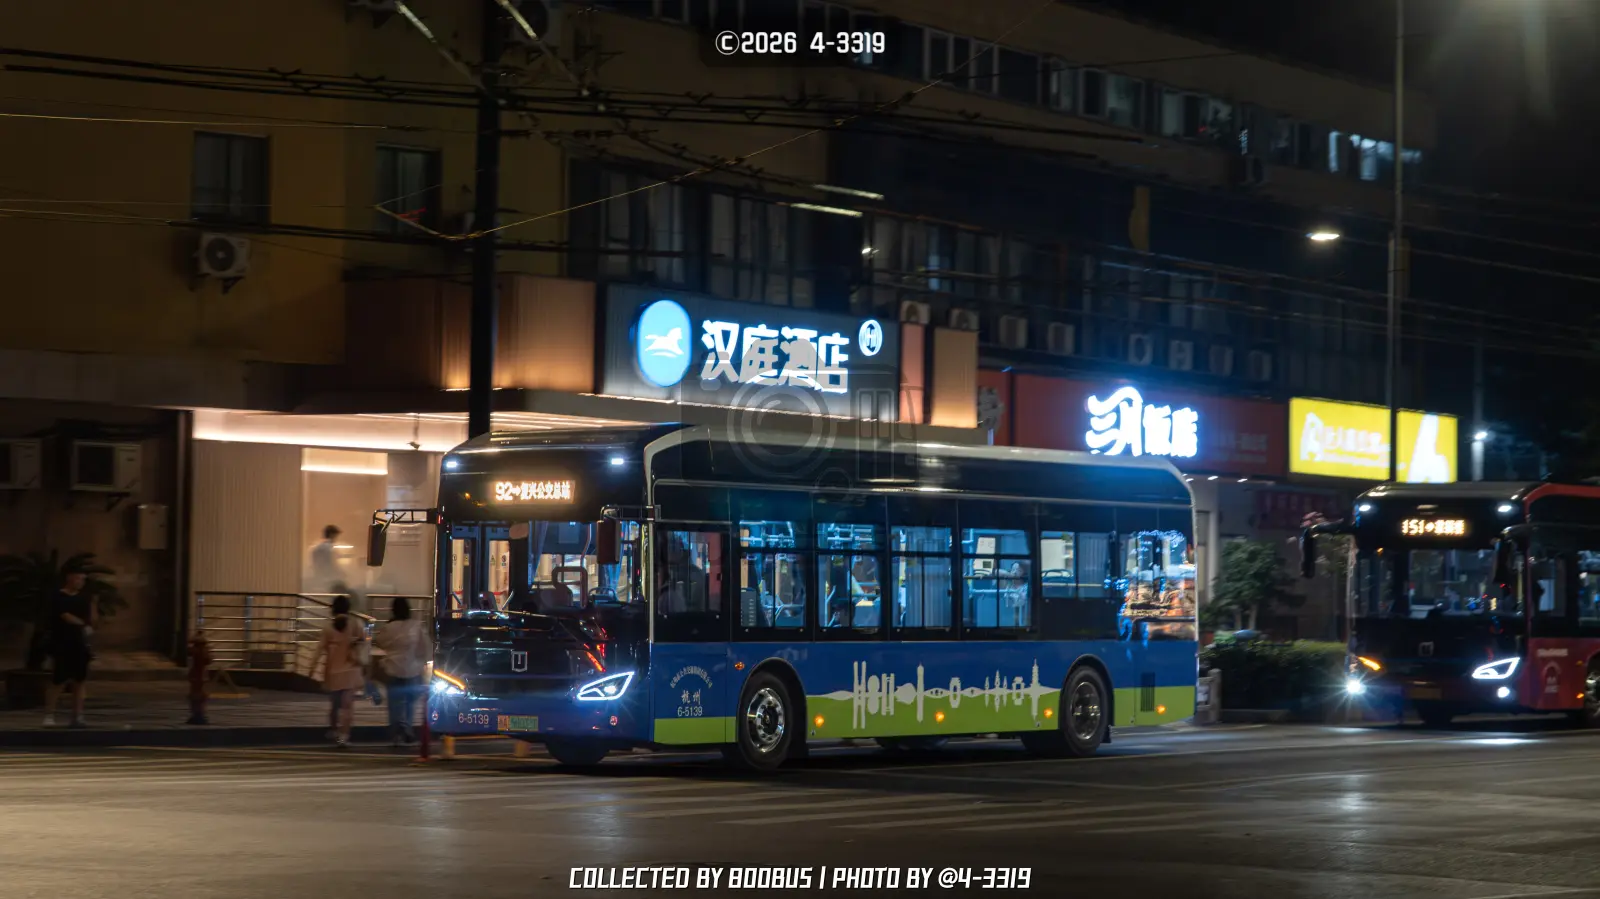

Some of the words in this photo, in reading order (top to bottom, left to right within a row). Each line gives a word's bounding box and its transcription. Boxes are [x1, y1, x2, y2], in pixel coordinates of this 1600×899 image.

[700, 319, 850, 393] 汉庭酒店
[495, 481, 513, 501] 92
[458, 712, 489, 725] 6-5139
[677, 706, 703, 717] 6-5139
